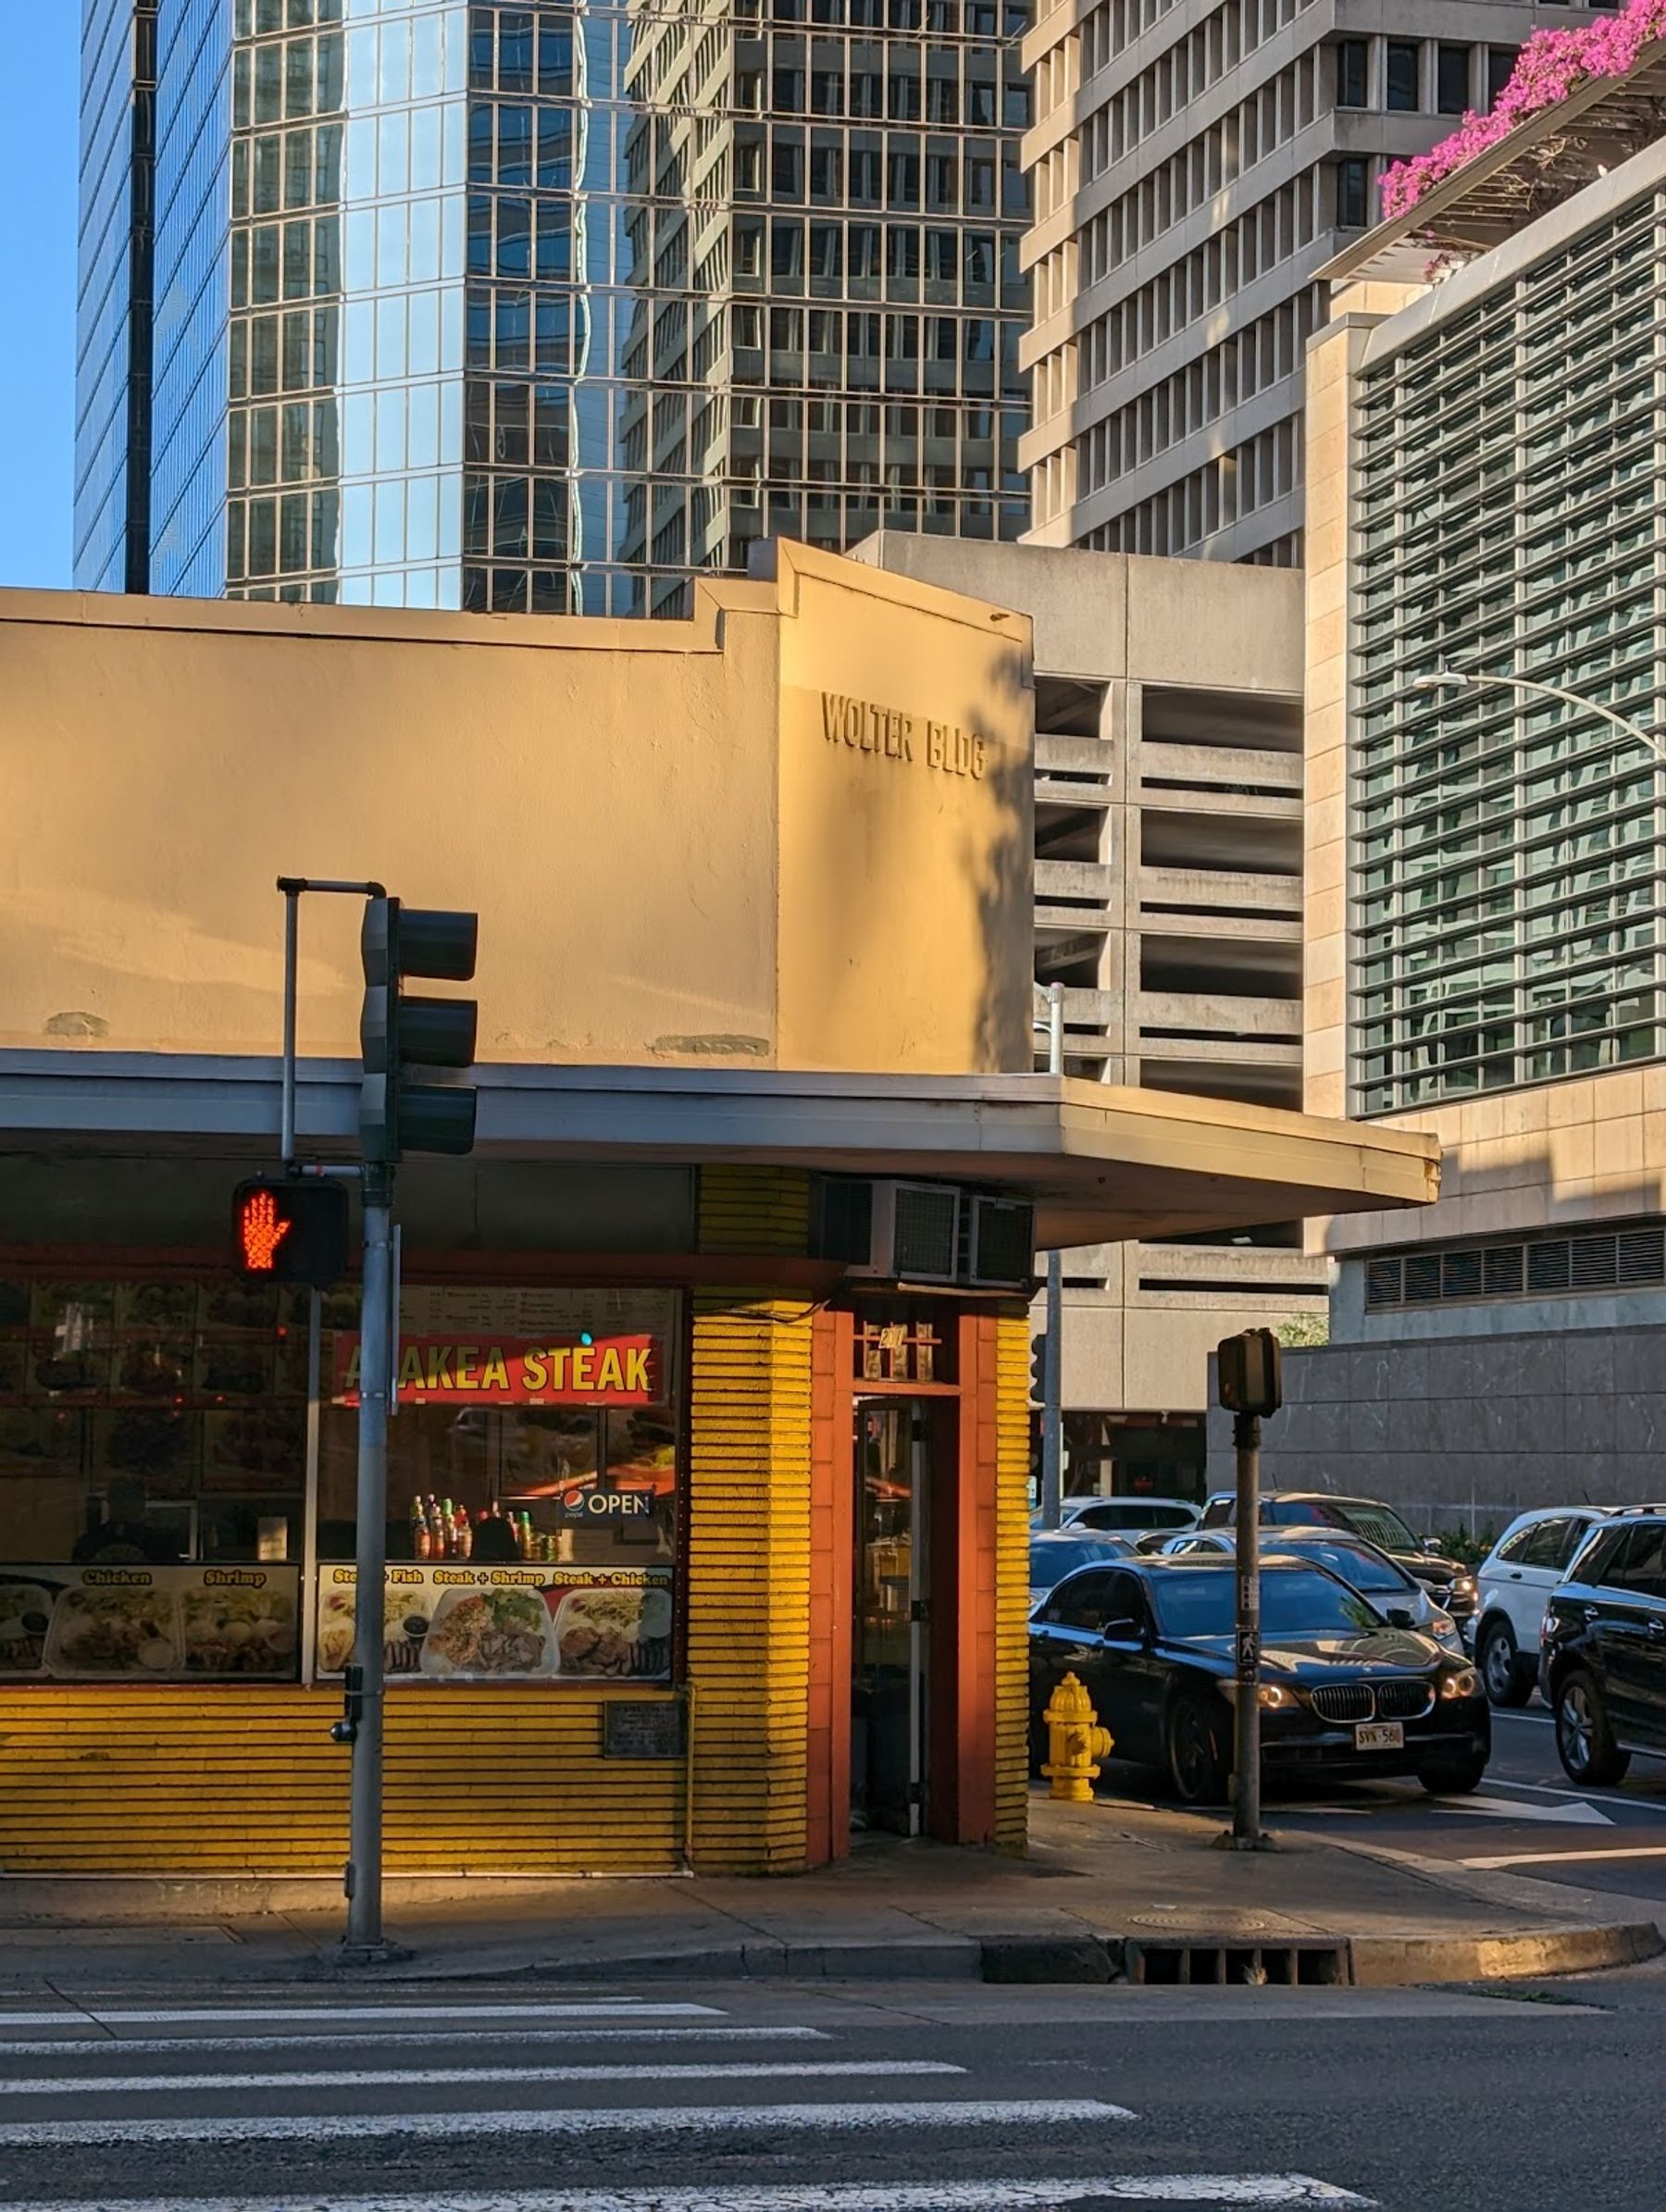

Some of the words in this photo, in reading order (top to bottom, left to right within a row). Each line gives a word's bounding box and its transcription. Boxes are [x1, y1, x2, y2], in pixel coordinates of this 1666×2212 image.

[821, 690, 914, 762] WOLTER
[926, 719, 987, 780] BLDG
[344, 1345, 510, 1391] AAKEA
[522, 1347, 653, 1392] STEAK
[588, 1494, 650, 1514] OPEN
[81, 1569, 153, 1585] Chicken
[204, 1569, 267, 1588] Shrimp
[333, 1569, 357, 1584] Ste
[392, 1569, 424, 1584] Fish
[433, 1569, 475, 1584] Steak
[478, 1572, 489, 1584] +
[491, 1570, 546, 1587] Shrimp
[553, 1571, 594, 1585] Steak
[598, 1574, 607, 1585] +
[611, 1571, 669, 1586] Chicken
